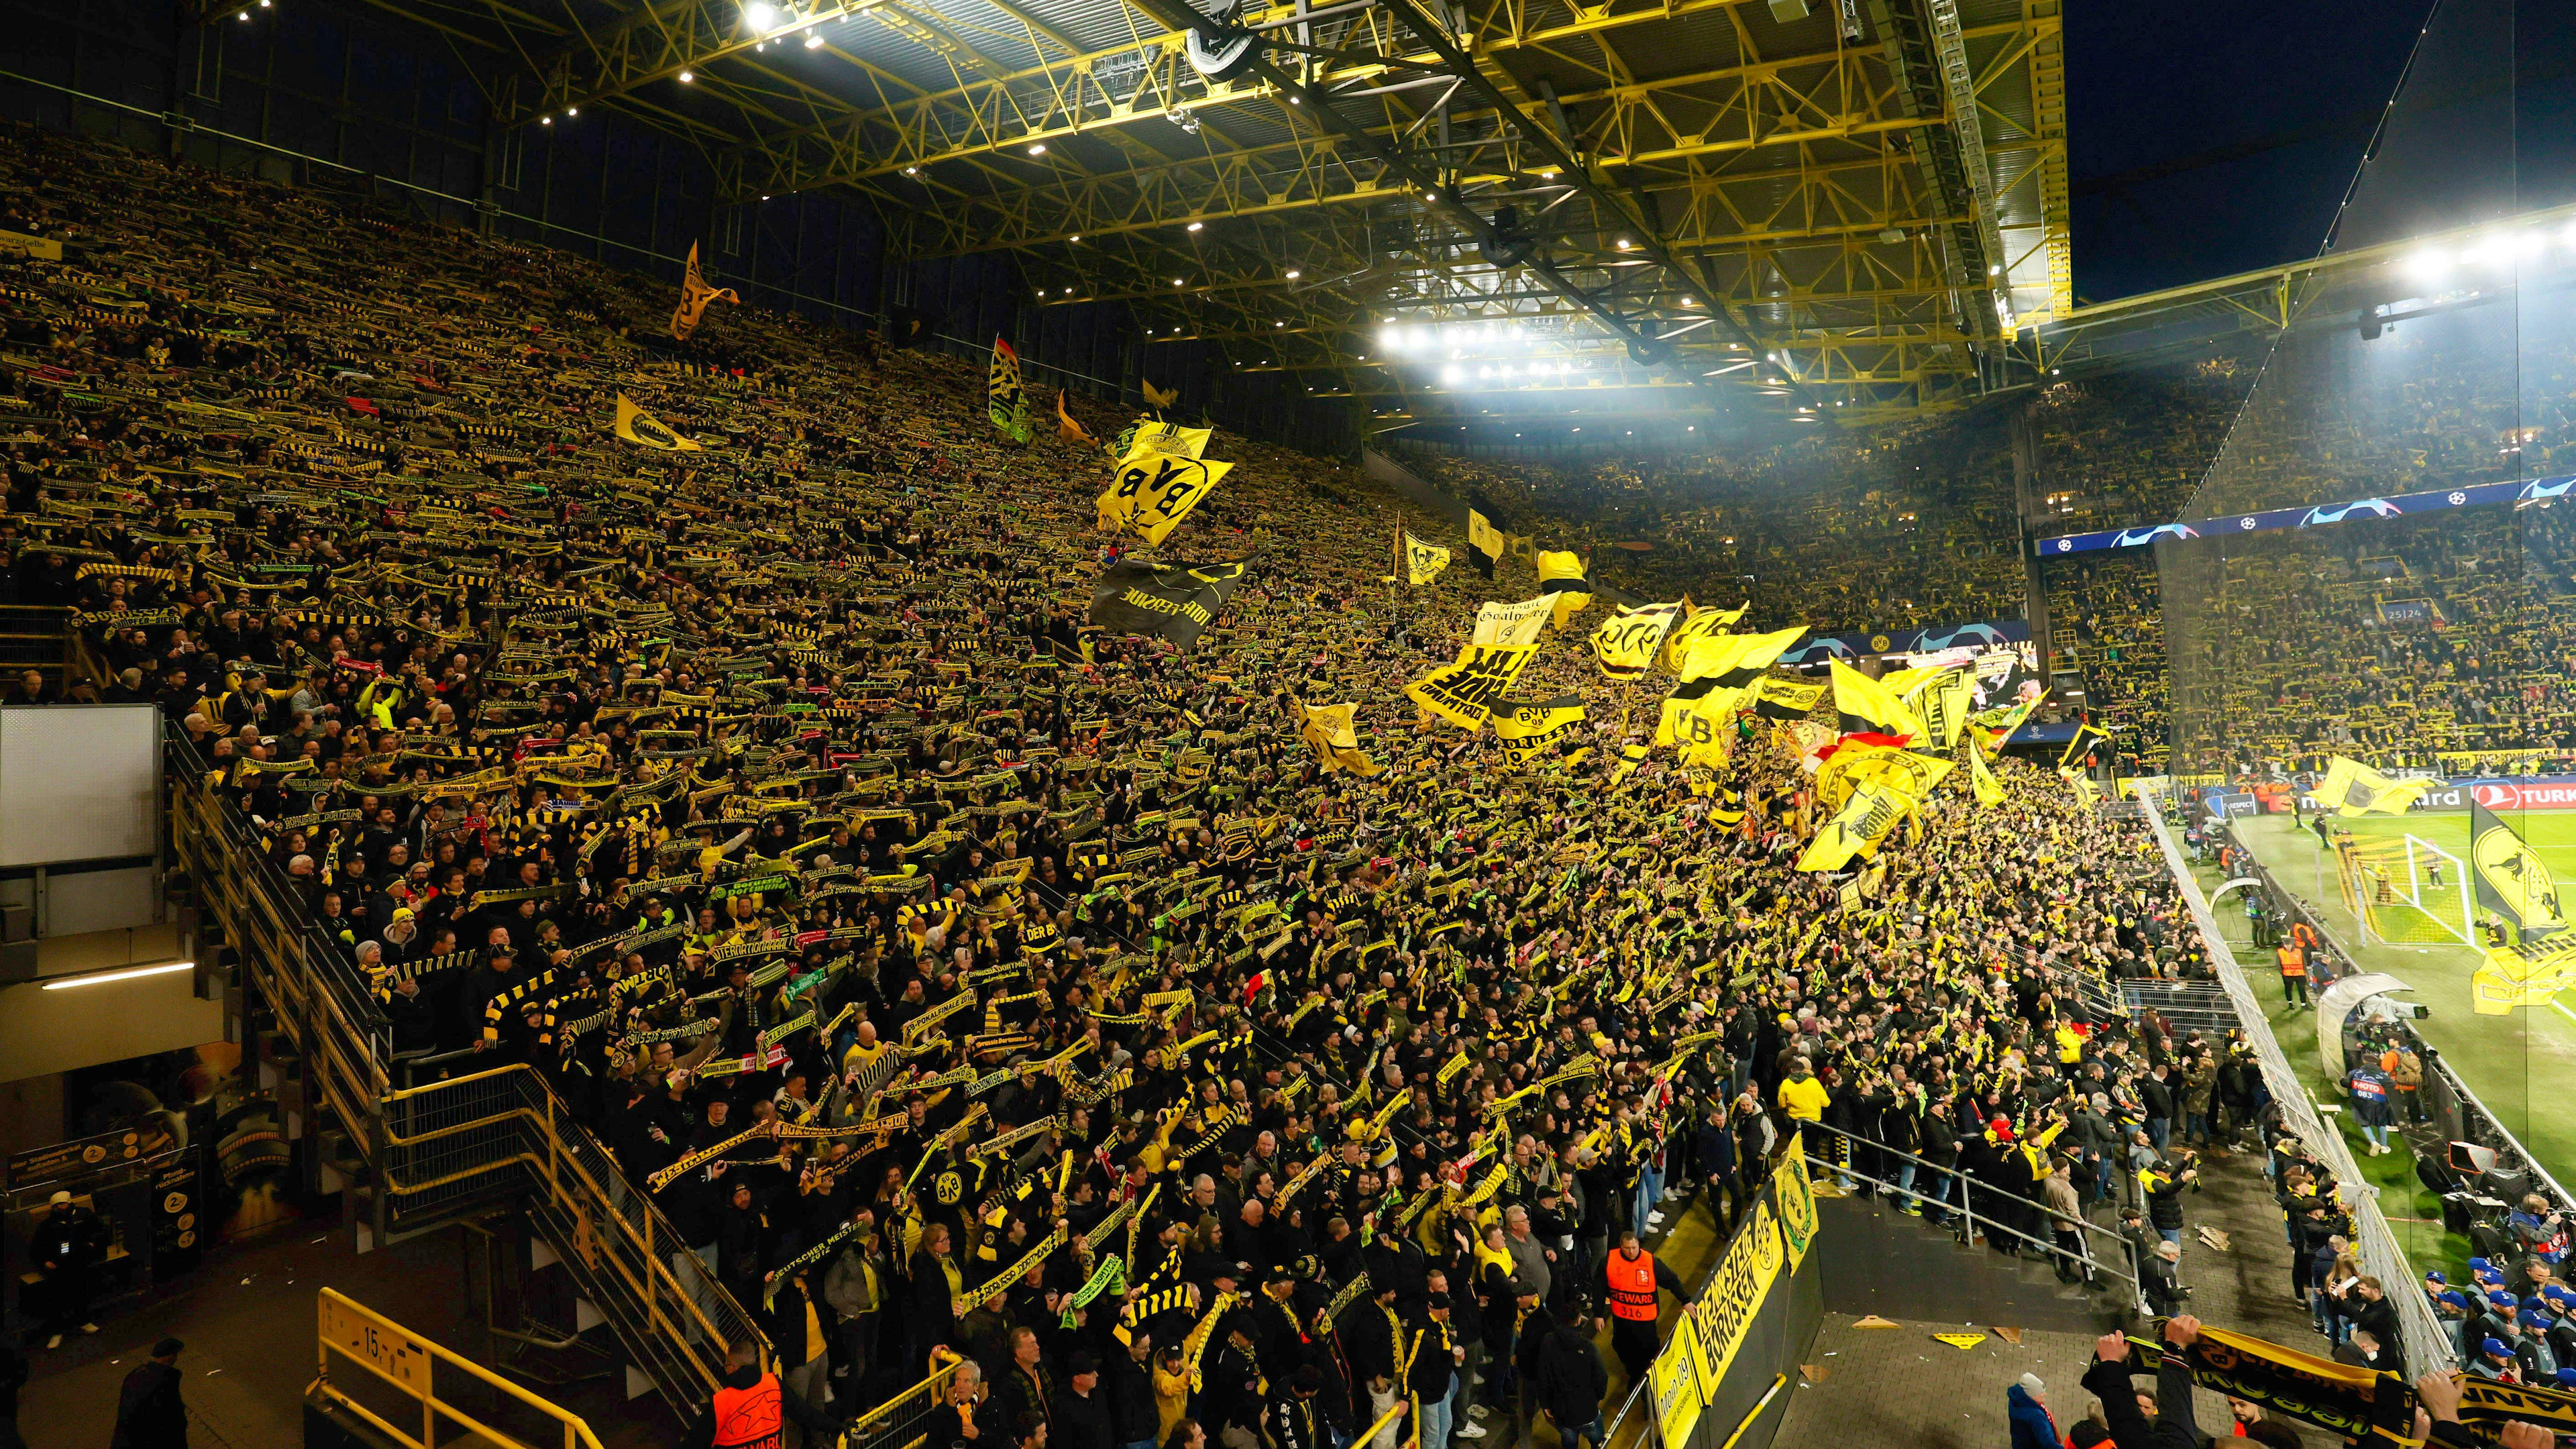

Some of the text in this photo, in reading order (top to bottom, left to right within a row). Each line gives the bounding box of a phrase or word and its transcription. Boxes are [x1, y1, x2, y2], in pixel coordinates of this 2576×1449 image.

[1874, 638, 1888, 648] BVB
[1520, 707, 1551, 722] BVB
[1532, 718, 1544, 727] 09
[2229, 801, 2253, 809] RESPECT
[284, 810, 362, 828] BORUSSIA DORTMUND
[682, 818, 719, 829] BORUSSIA
[727, 882, 787, 896] Dortmund
[733, 875, 783, 889] Borussia
[1026, 925, 1045, 941] DER
[1123, 956, 1150, 967] DORTMUND
[961, 994, 975, 1006] 2016
[998, 1035, 1027, 1045] Dortmund
[1540, 1071, 1568, 1085] BORUSSIA
[983, 1118, 1049, 1152] BORUSSIA DORTMUND
[939, 1178, 959, 1201] BVB
[827, 1220, 864, 1246] MEISTER
[1757, 1213, 1770, 1256] BVB
[810, 1246, 830, 1263] 2012
[984, 1241, 1051, 1297] BORUSSIA DORTMUND
[1696, 1221, 1754, 1342] RENNSTEIG
[1622, 1306, 1642, 1318] 316
[1705, 1258, 1759, 1375] BORUSSEN
[365, 1326, 378, 1358] 15
[1678, 1356, 1689, 1388] 09
